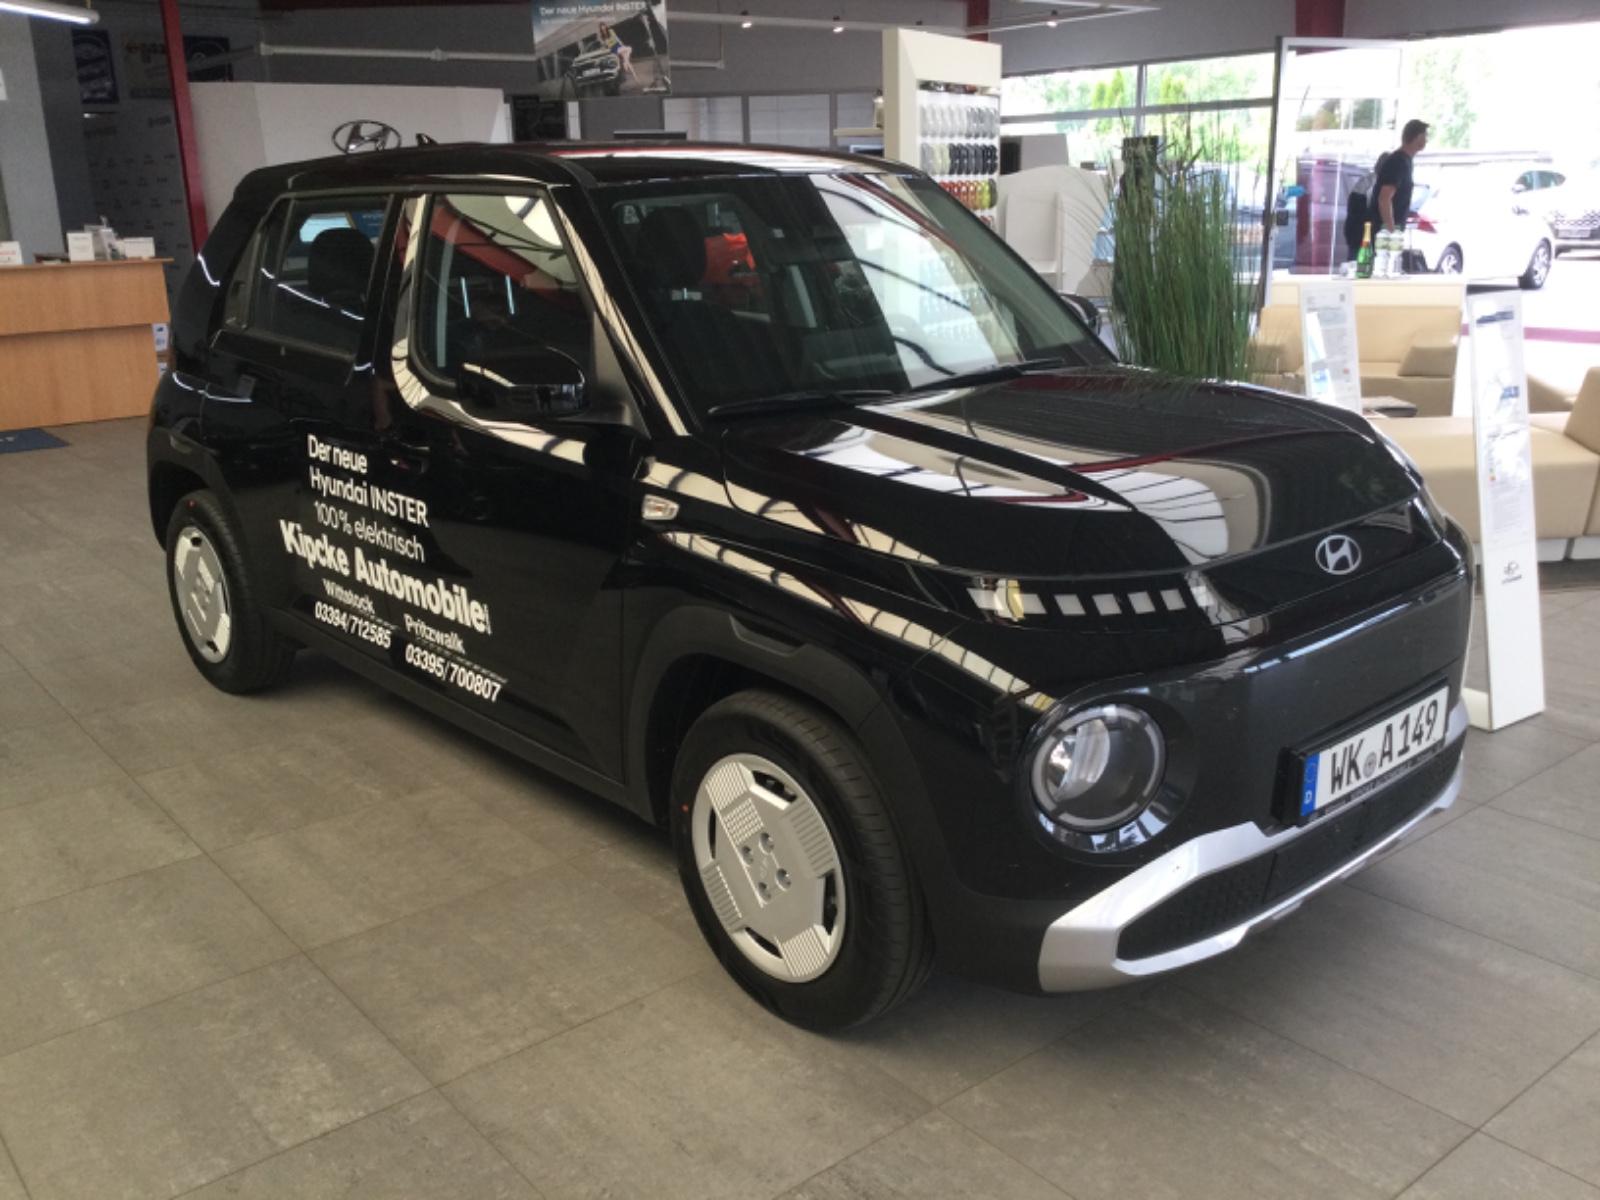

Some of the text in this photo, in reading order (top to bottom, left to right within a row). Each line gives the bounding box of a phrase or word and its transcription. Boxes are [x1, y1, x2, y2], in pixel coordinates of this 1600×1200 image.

[307, 434, 368, 474] Der neue
[309, 465, 429, 528] Hyundai INSTER
[354, 517, 426, 563] elektrisch
[279, 519, 350, 576] Kipcke
[355, 547, 488, 634] Automobile
[403, 613, 466, 655] Pritzwalk
[1330, 739, 1363, 795] WK
